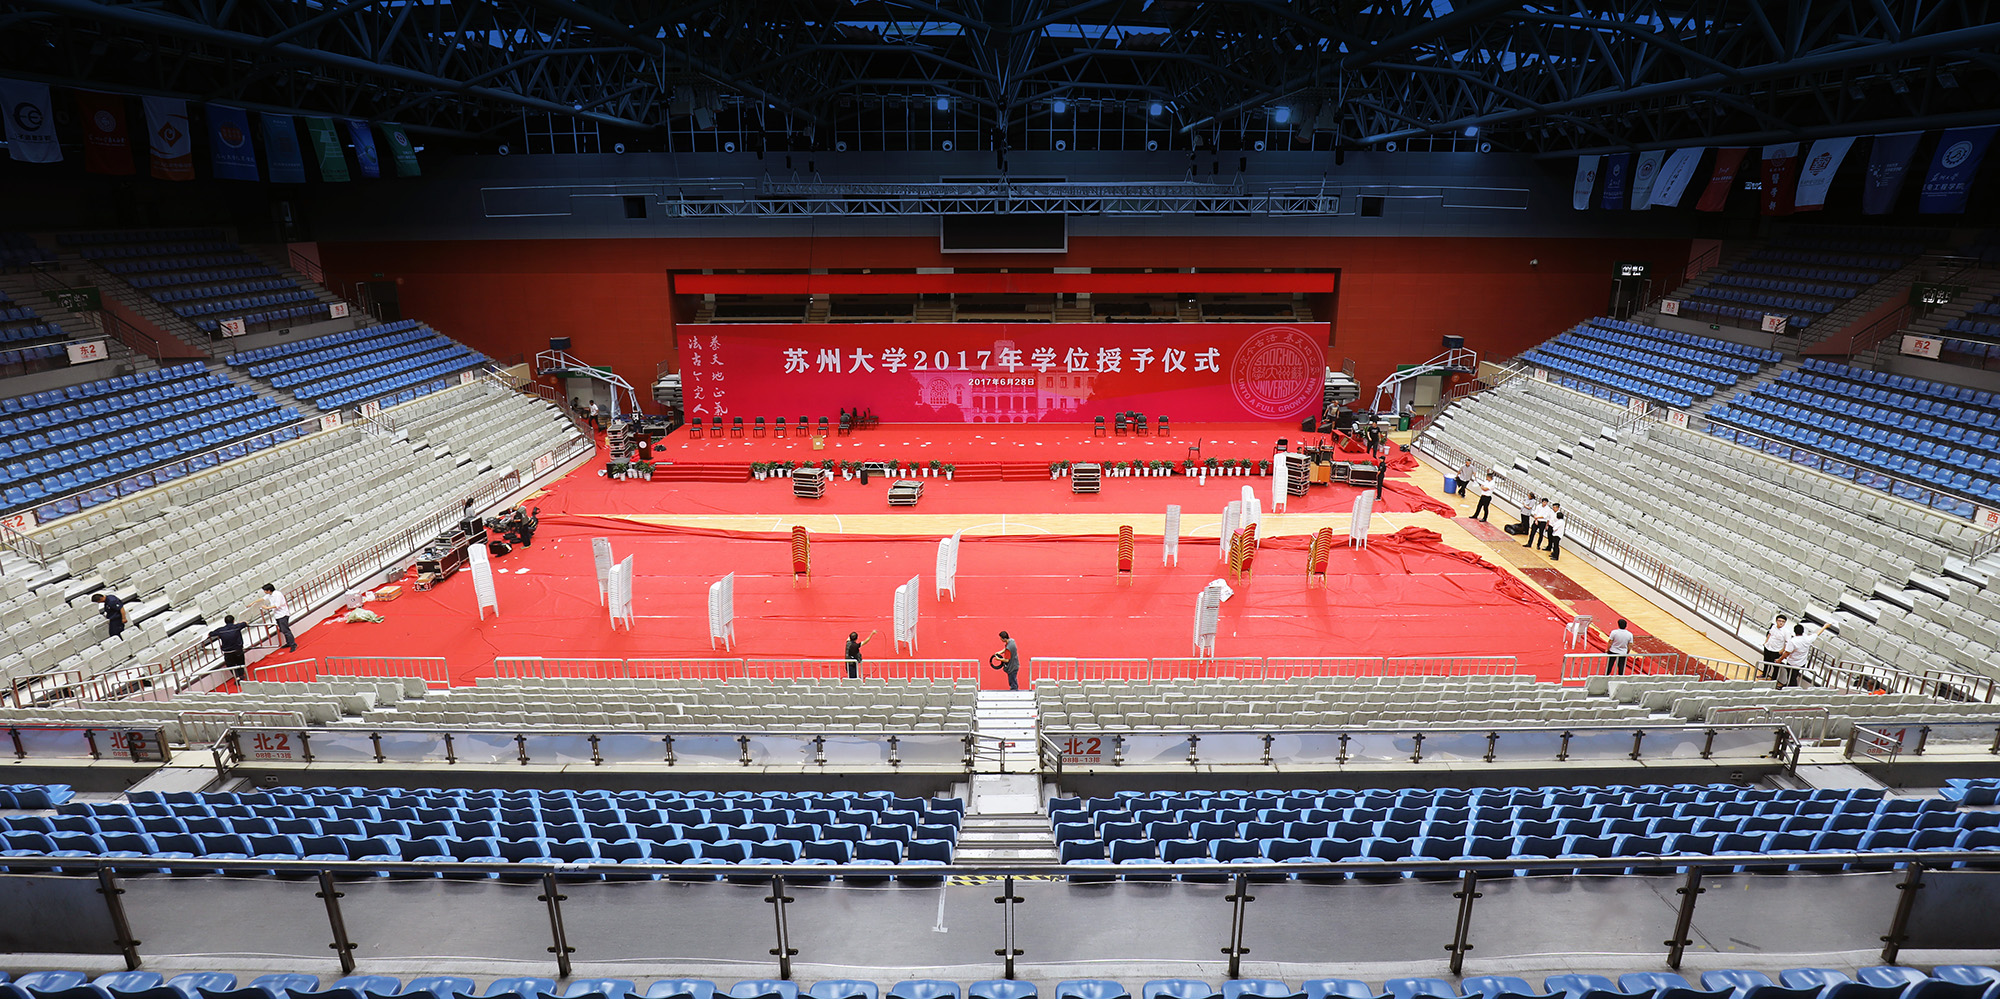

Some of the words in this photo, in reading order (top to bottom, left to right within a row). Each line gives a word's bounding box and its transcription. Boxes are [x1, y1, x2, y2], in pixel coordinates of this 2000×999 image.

[80, 344, 96, 355] 东2
[1914, 340, 1931, 350] 西2
[782, 347, 1221, 374] 苏州大学2017年学位授予仪式
[1254, 348, 1303, 366] SOOCHOW
[968, 378, 1035, 386] 2017年6月28日
[1253, 380, 1302, 399] UNIVERSITY
[1238, 378, 1251, 399] UNTO
[1255, 403, 1275, 413] FULL
[1278, 395, 1306, 413] GROWN
[1305, 378, 1317, 397] MAN
[325, 414, 337, 425] 东2
[1673, 411, 1684, 422] 西2
[1, 515, 25, 532] 东2
[1986, 510, 2000, 524] 西
[253, 733, 290, 751] 北2
[1871, 728, 1906, 746] 北1
[1063, 737, 1101, 755] 北2
